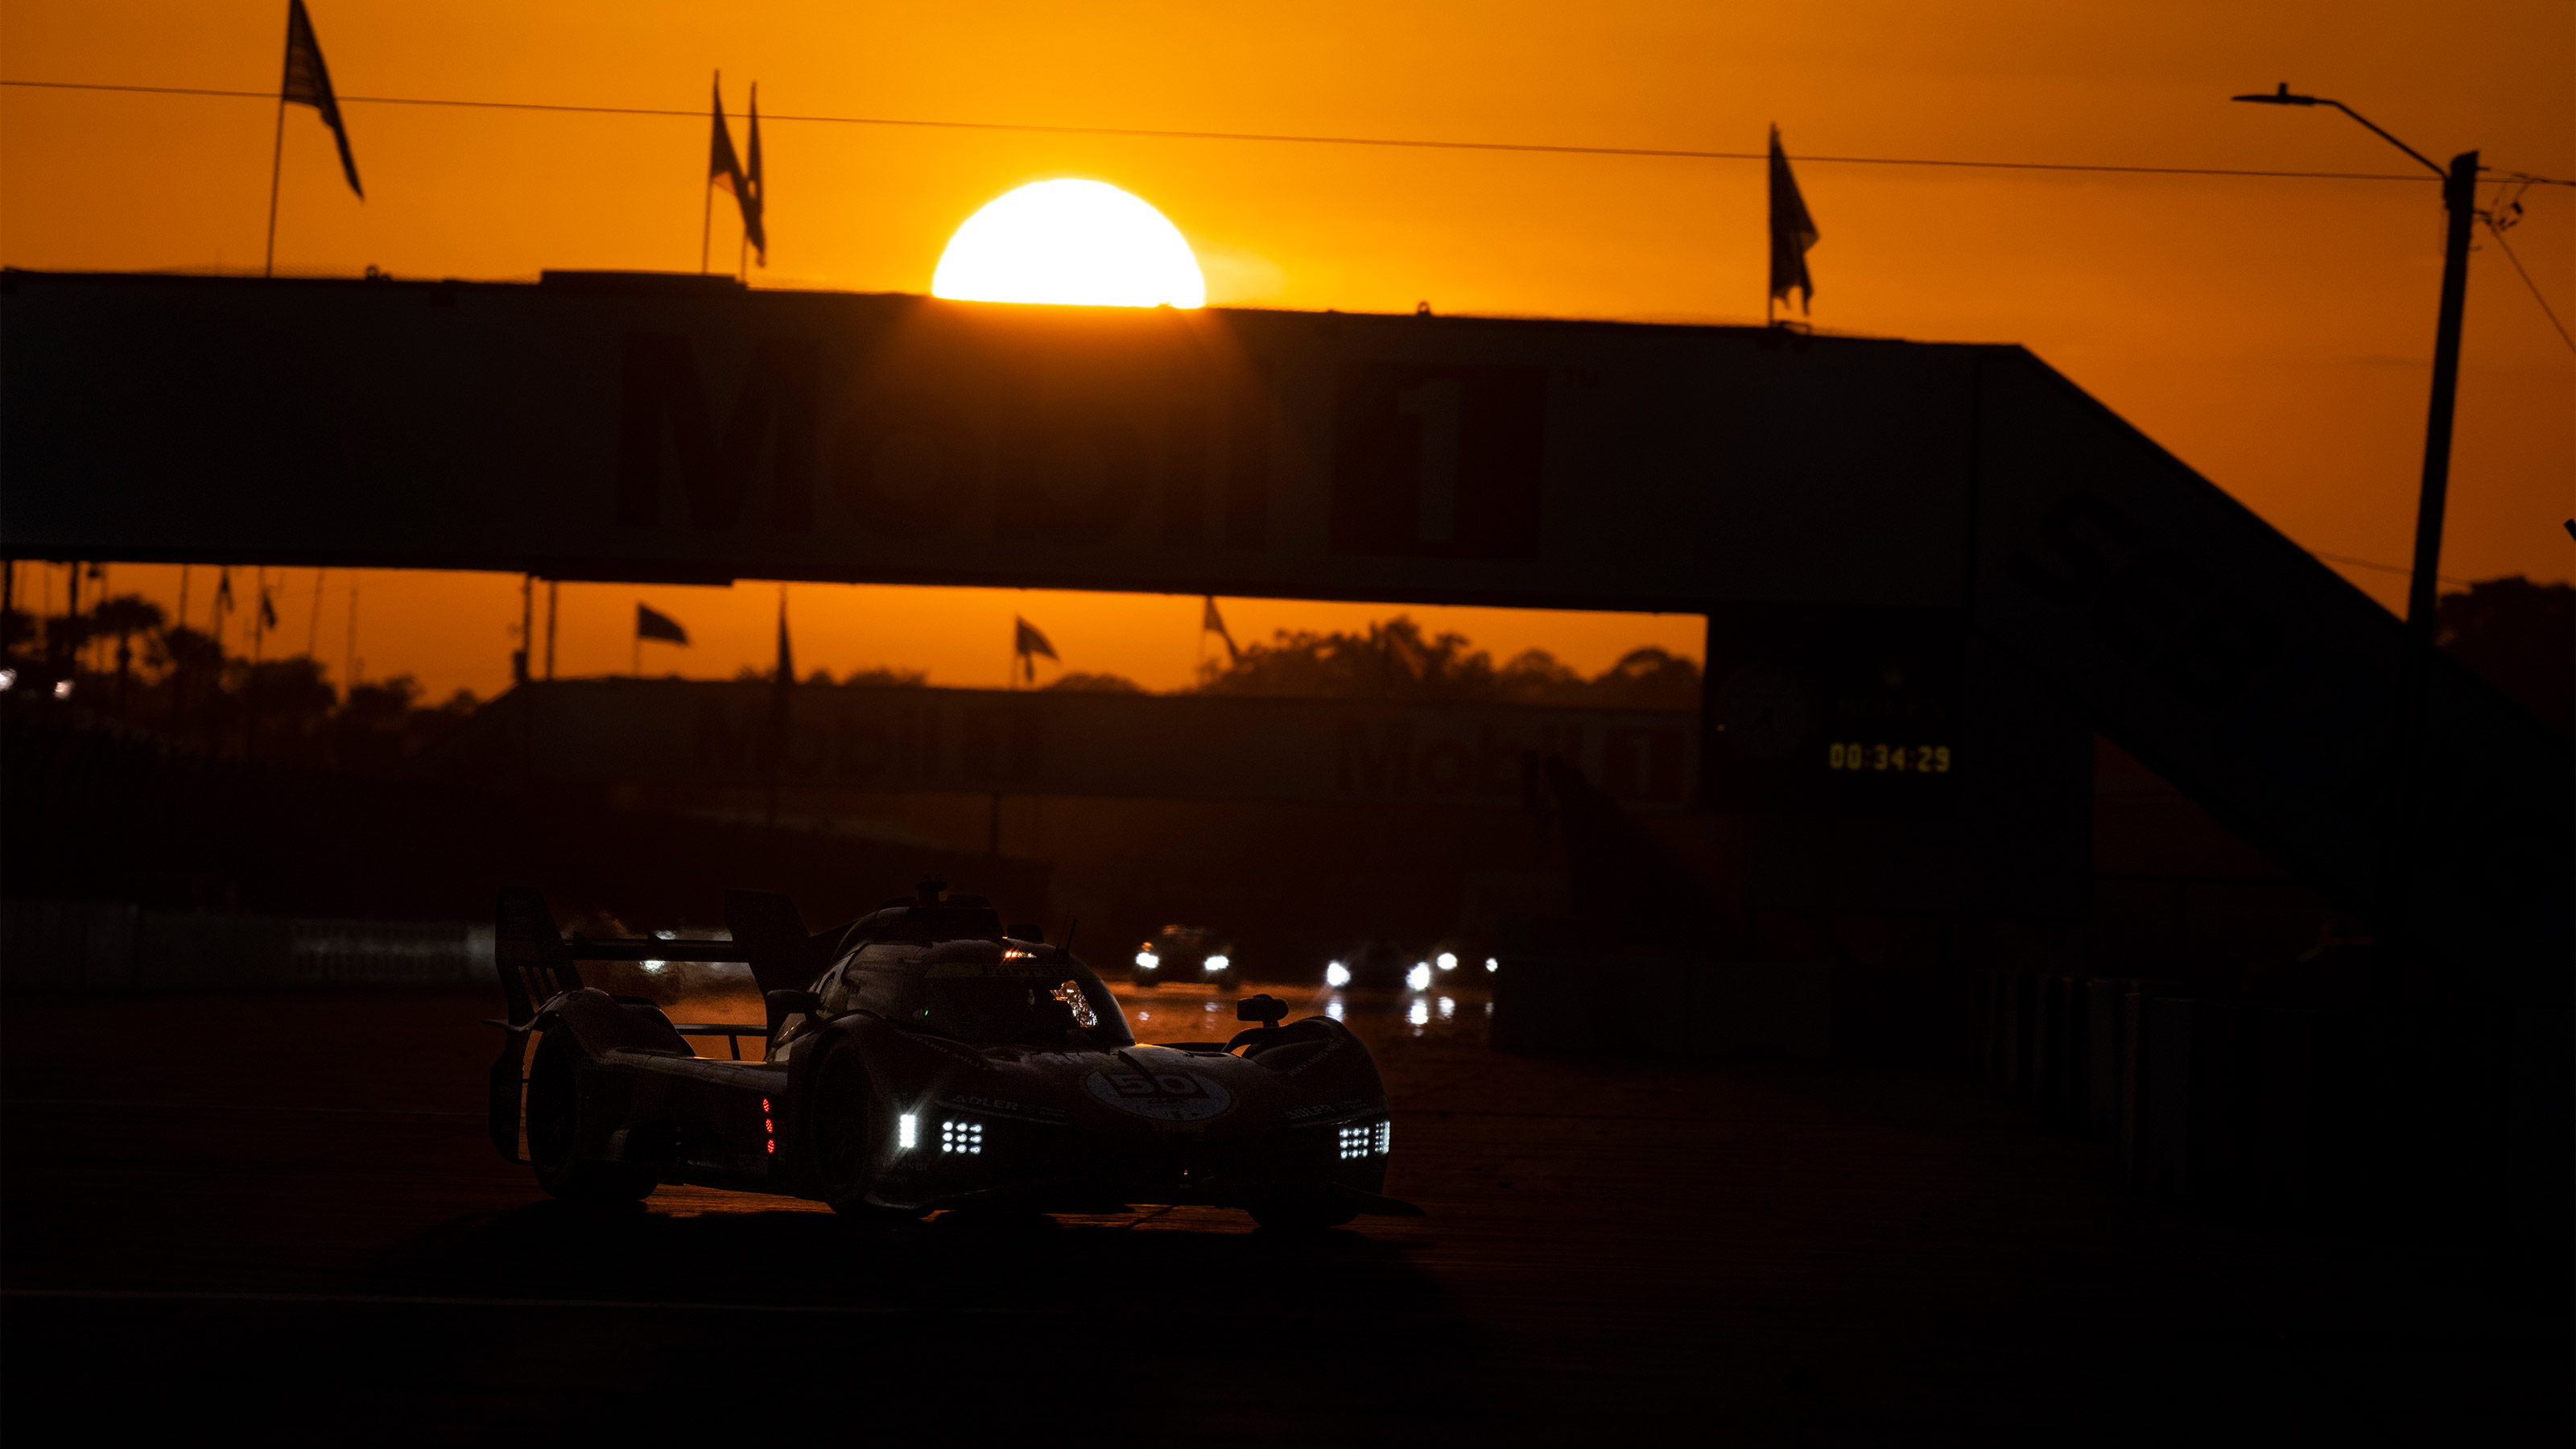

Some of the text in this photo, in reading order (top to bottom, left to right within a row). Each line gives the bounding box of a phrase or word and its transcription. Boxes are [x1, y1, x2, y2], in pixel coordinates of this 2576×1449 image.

[616, 332, 1268, 551] Mobil
[696, 701, 943, 780] Mobil
[1828, 741, 1951, 773] 00:34:29
[1108, 1074, 1198, 1094] 50
[952, 1095, 1019, 1110] ADLER
